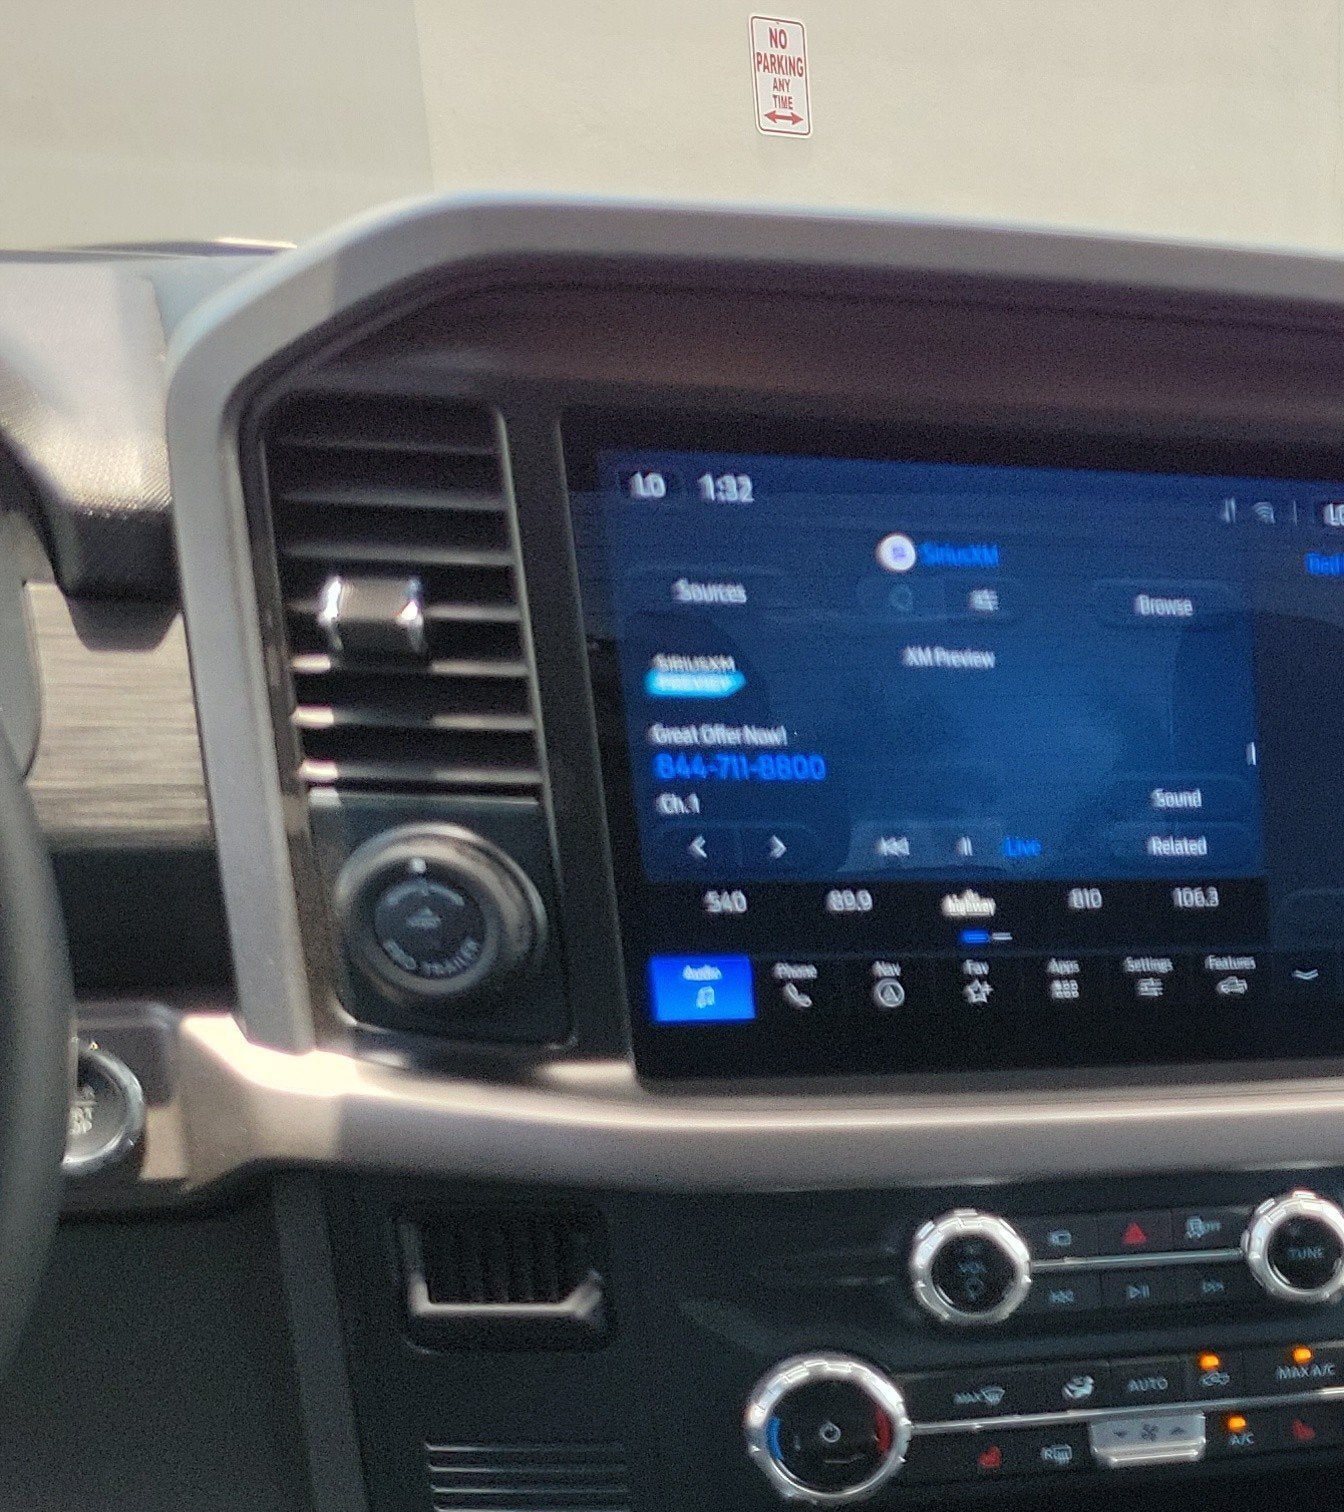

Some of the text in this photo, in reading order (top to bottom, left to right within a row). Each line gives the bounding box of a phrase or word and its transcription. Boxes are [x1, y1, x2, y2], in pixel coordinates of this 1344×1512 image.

[769, 27, 788, 49] NO
[756, 52, 804, 77] PARKING
[772, 78, 790, 92] ANY
[772, 94, 794, 110] TIME
[699, 473, 754, 502] 1:32
[1134, 594, 1193, 617] Browse
[1150, 788, 1202, 809] Sound
[1147, 835, 1207, 857] Related
[1276, 1363, 1335, 1380] MAX A/C
[1127, 1377, 1168, 1393] AUTO
[1230, 1433, 1254, 1446] A/C
